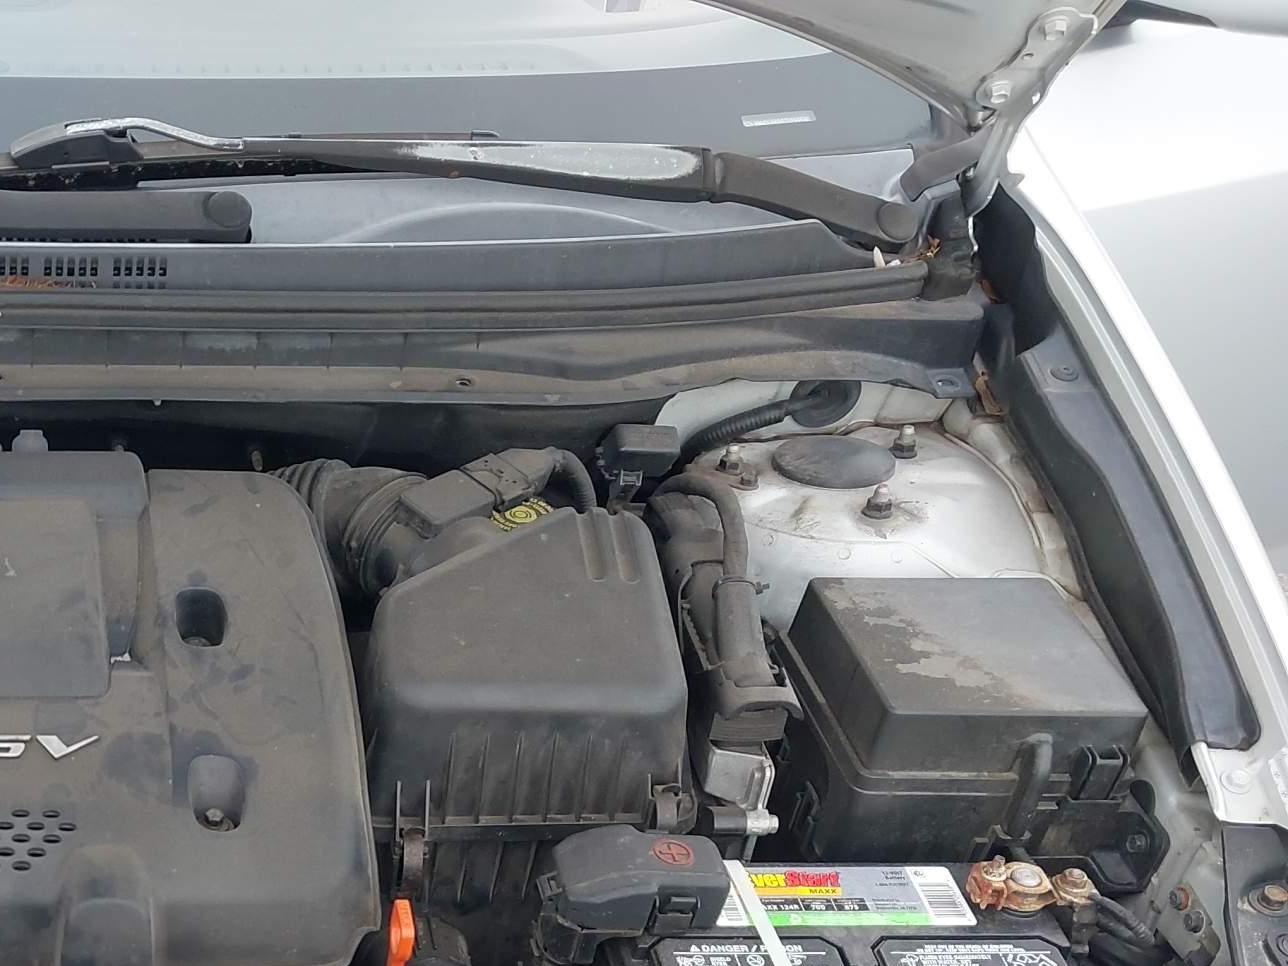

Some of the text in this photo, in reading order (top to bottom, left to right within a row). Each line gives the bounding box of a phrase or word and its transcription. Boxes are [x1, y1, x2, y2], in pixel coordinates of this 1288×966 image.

[746, 870, 841, 888] verStart
[701, 944, 749, 953] DANGER
[759, 944, 803, 953] PON
